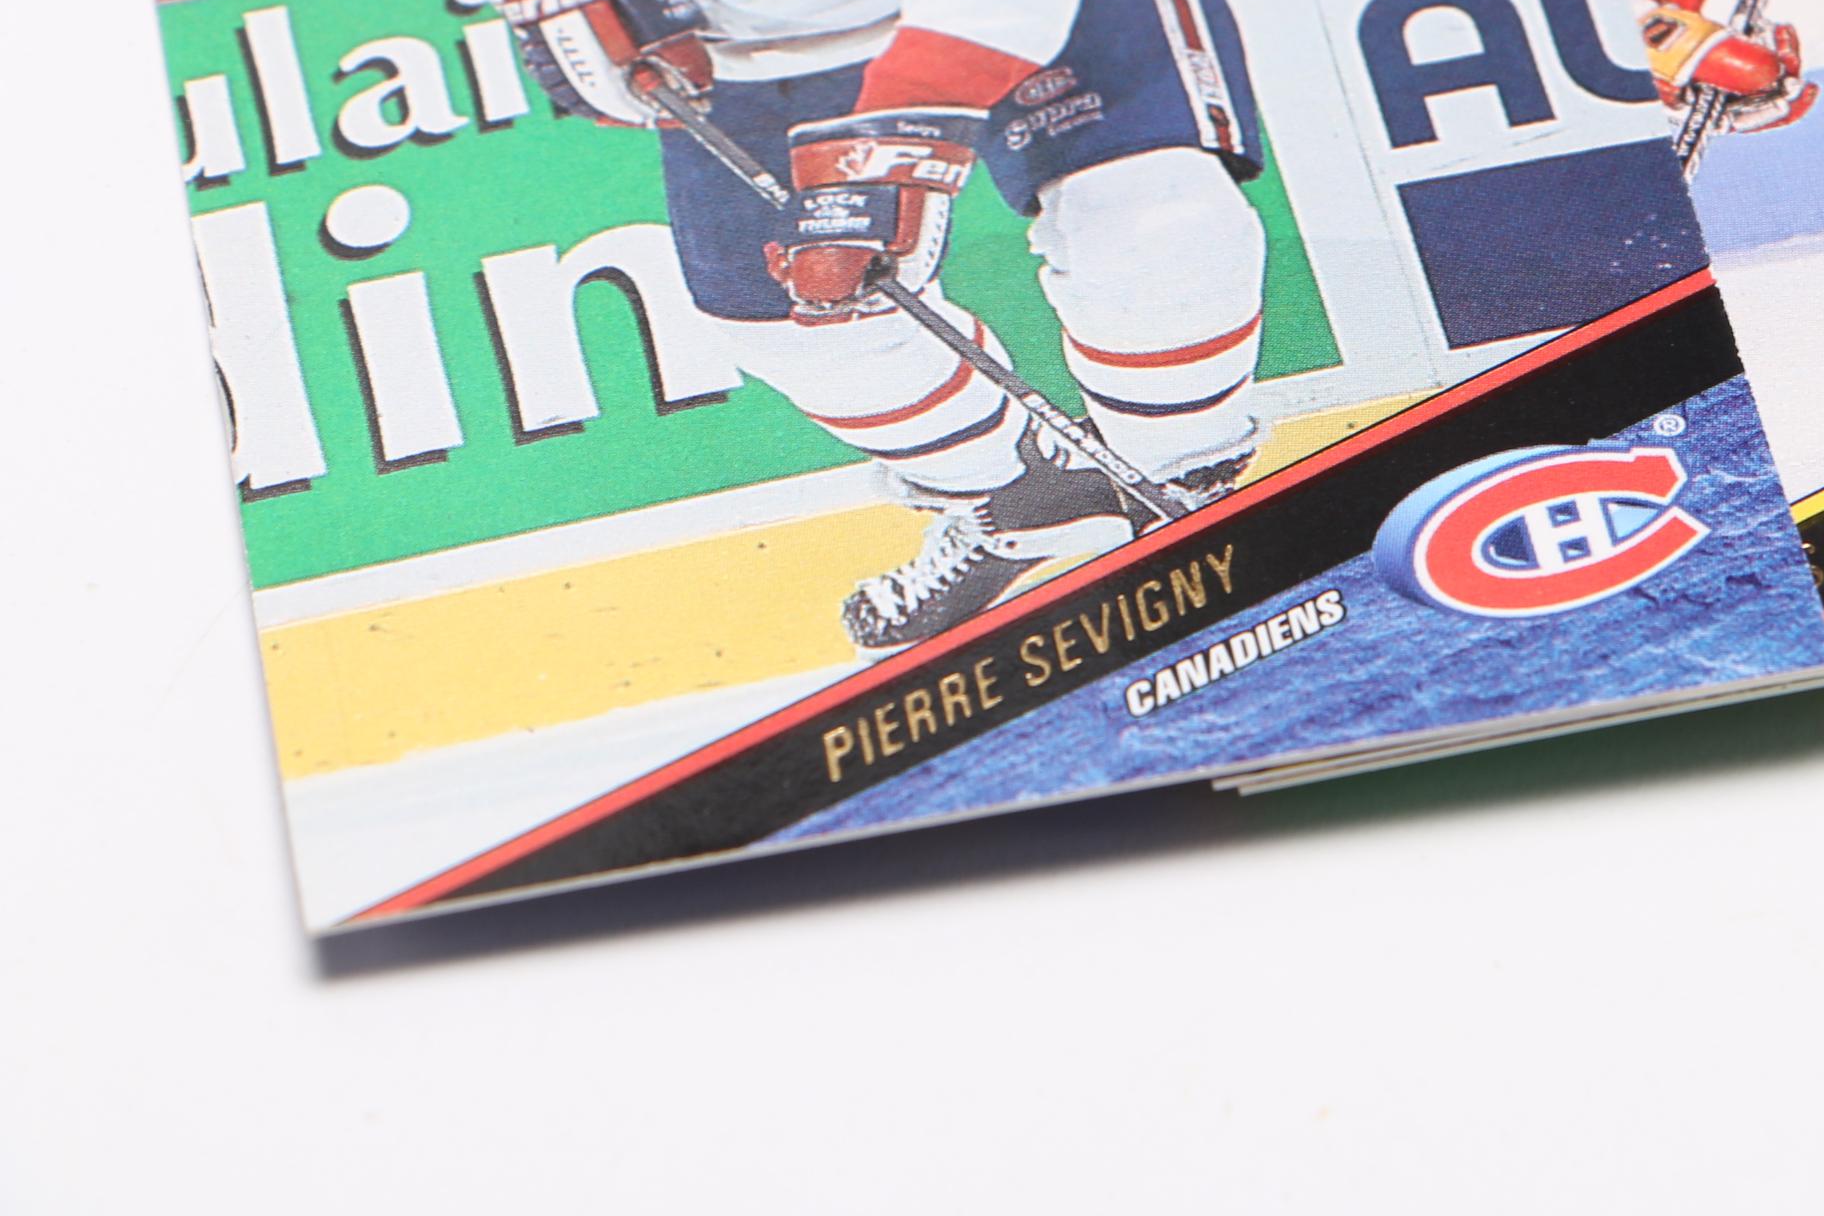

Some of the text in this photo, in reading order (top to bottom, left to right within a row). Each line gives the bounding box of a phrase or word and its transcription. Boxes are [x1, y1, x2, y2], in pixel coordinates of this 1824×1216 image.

[822, 543, 1236, 783] PIERRE SEVIGNY
[1125, 589, 1348, 718] CANADIENS
